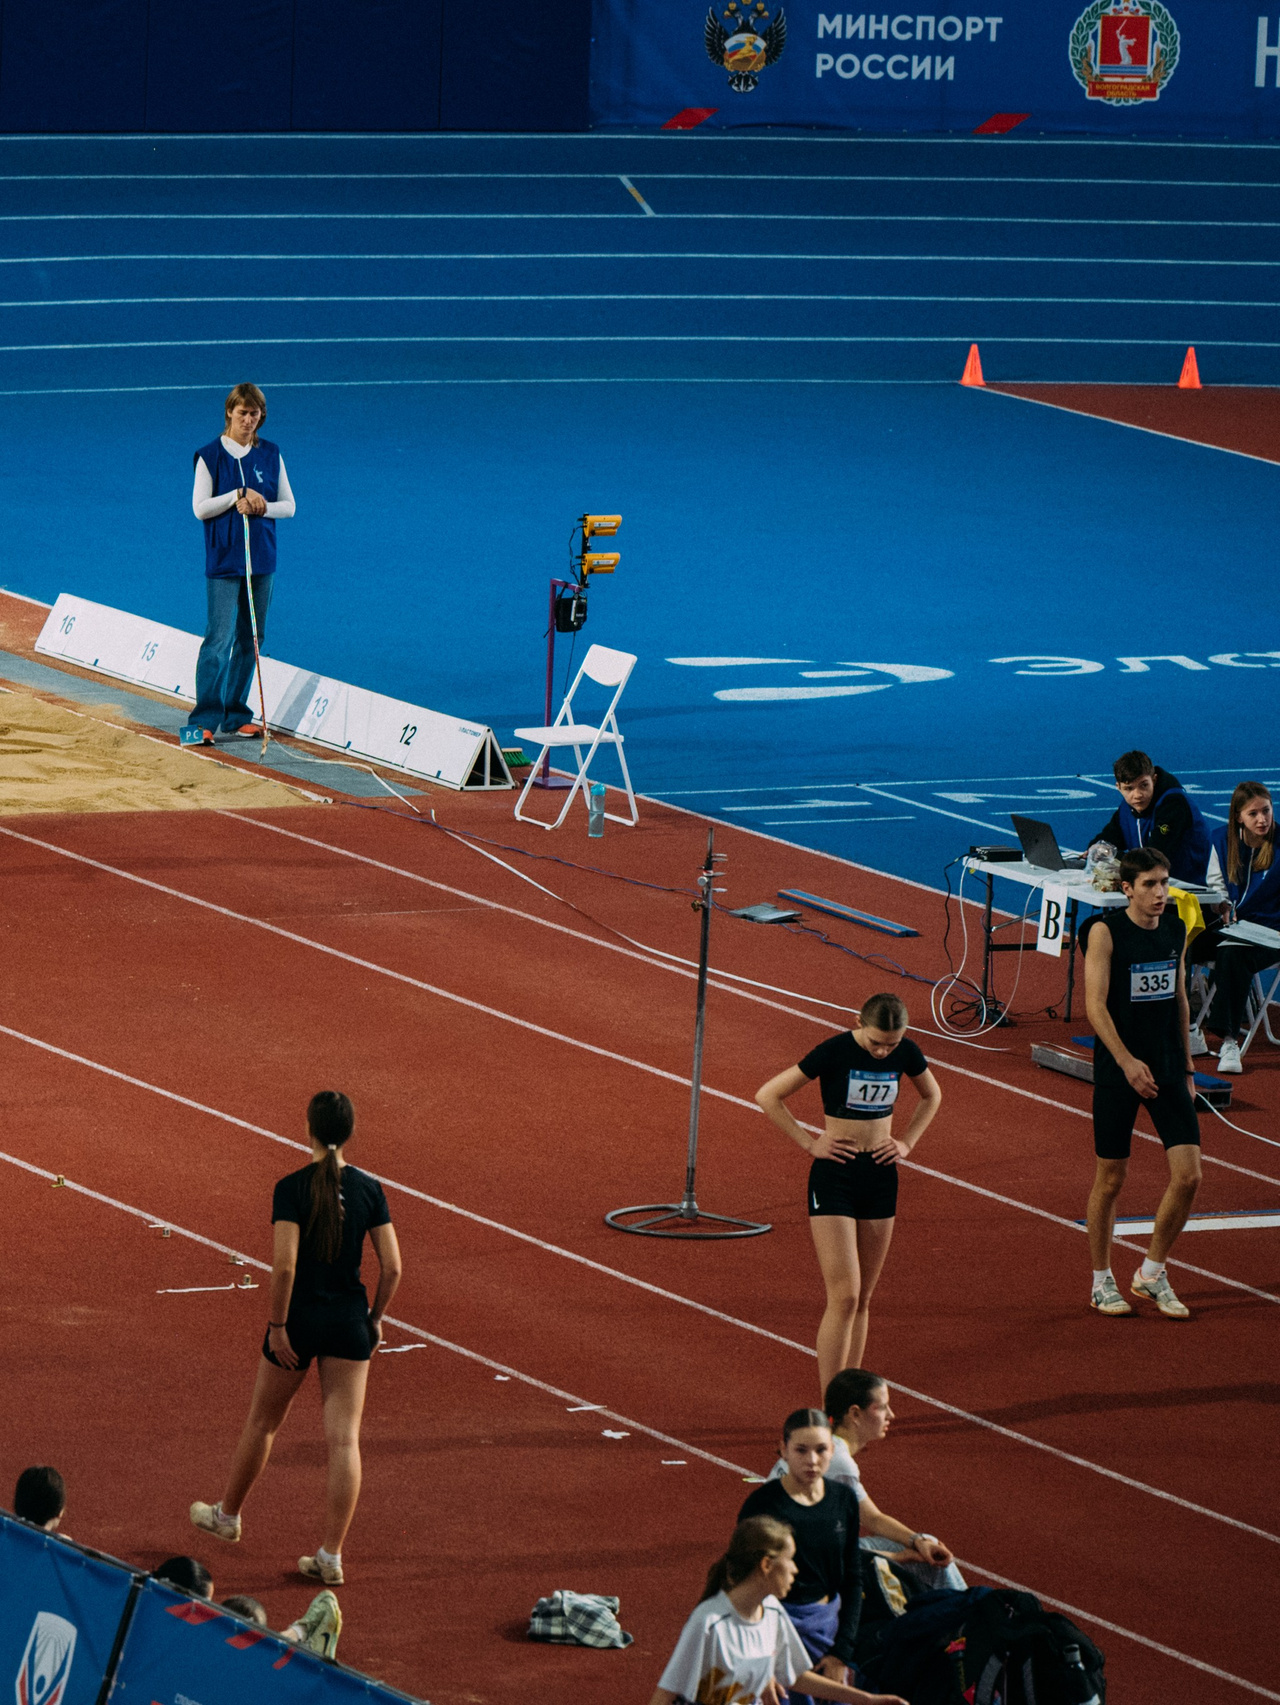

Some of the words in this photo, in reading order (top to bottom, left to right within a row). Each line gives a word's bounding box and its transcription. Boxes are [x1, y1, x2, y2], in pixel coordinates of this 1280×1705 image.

[818, 13, 1003, 43] МИНСПОРТ
[816, 53, 956, 82] РОССИИ
[59, 614, 76, 635] 16
[141, 641, 159, 662] 15
[311, 696, 329, 718] 13
[399, 723, 418, 746] 12
[1139, 973, 1169, 993] 335
[858, 1084, 891, 1101] 177
